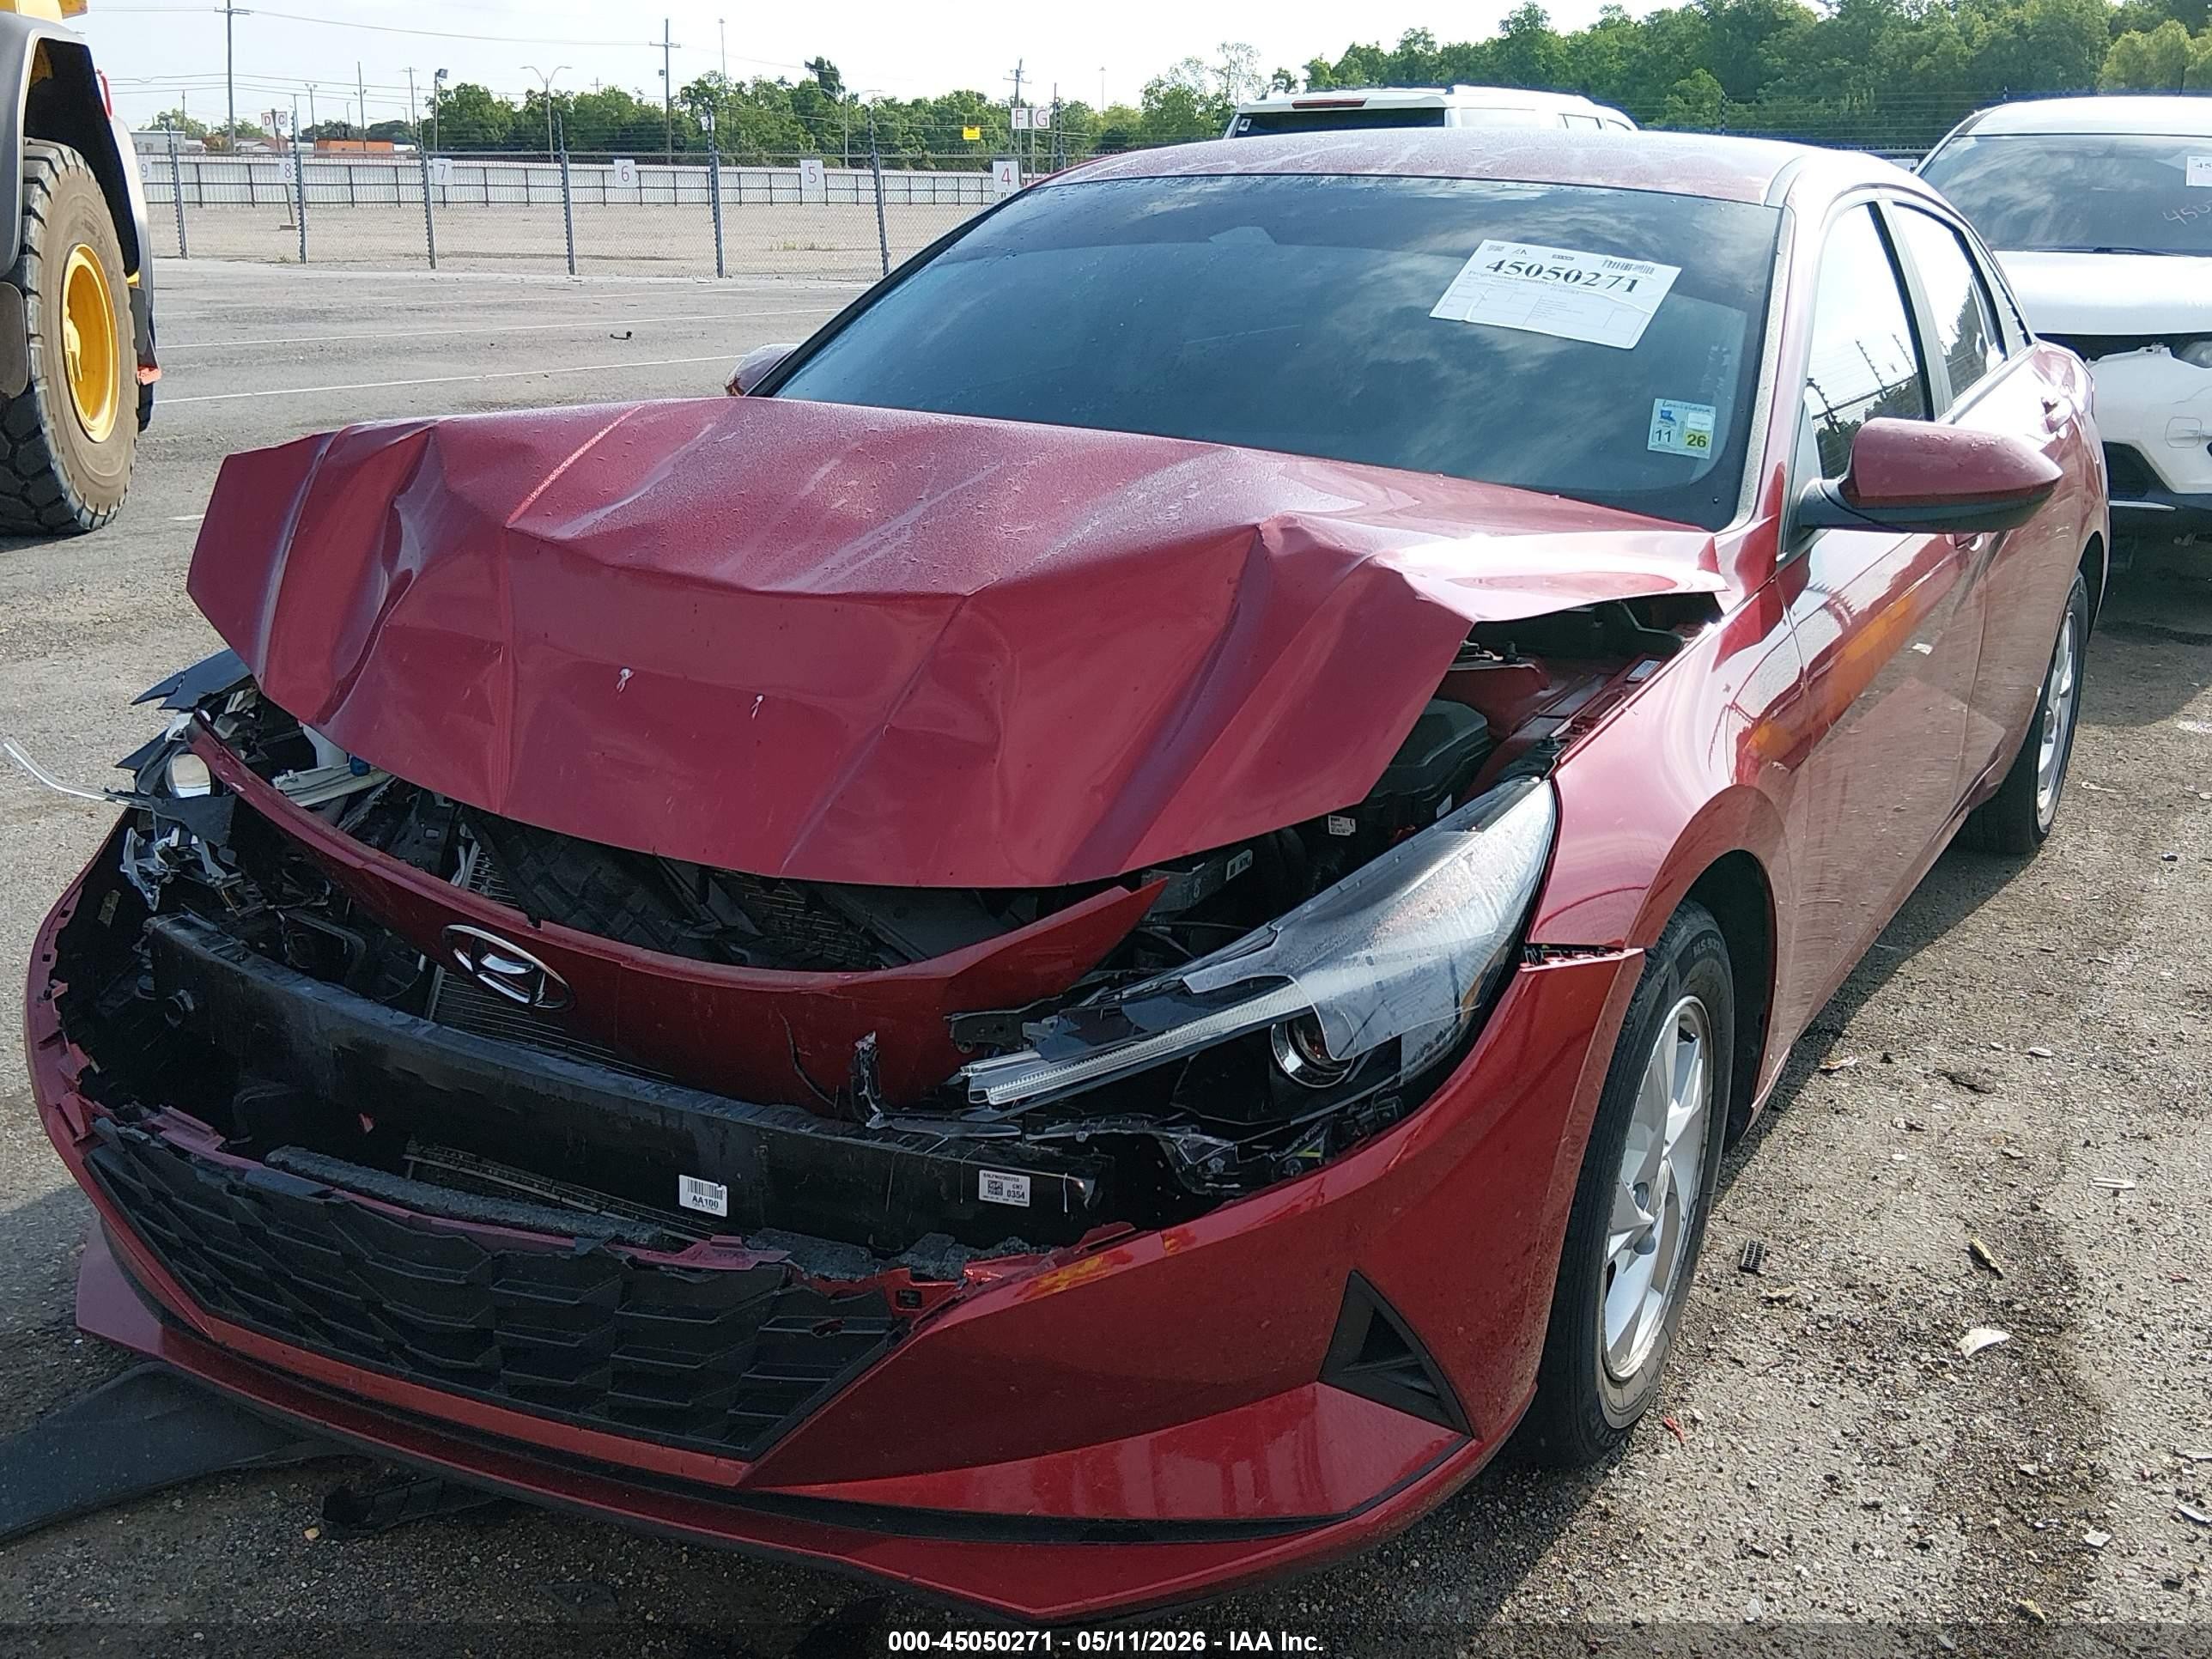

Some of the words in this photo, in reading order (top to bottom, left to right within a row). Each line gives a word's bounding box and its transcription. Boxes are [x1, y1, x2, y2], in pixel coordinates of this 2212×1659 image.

[264, 115, 271, 126] D
[278, 114, 285, 125] C
[1015, 109, 1024, 128] F
[1035, 109, 1048, 128] G
[141, 163, 149, 178] 9
[284, 163, 292, 179] 8
[439, 163, 447, 180] 7
[621, 165, 630, 183] 6
[808, 166, 817, 184] 5
[1000, 167, 1012, 186] 4
[1485, 258, 1639, 293] 45050271
[1655, 429, 1672, 444] 11
[1686, 433, 1708, 448] 26
[1006, 1189, 1025, 1200] 0354
